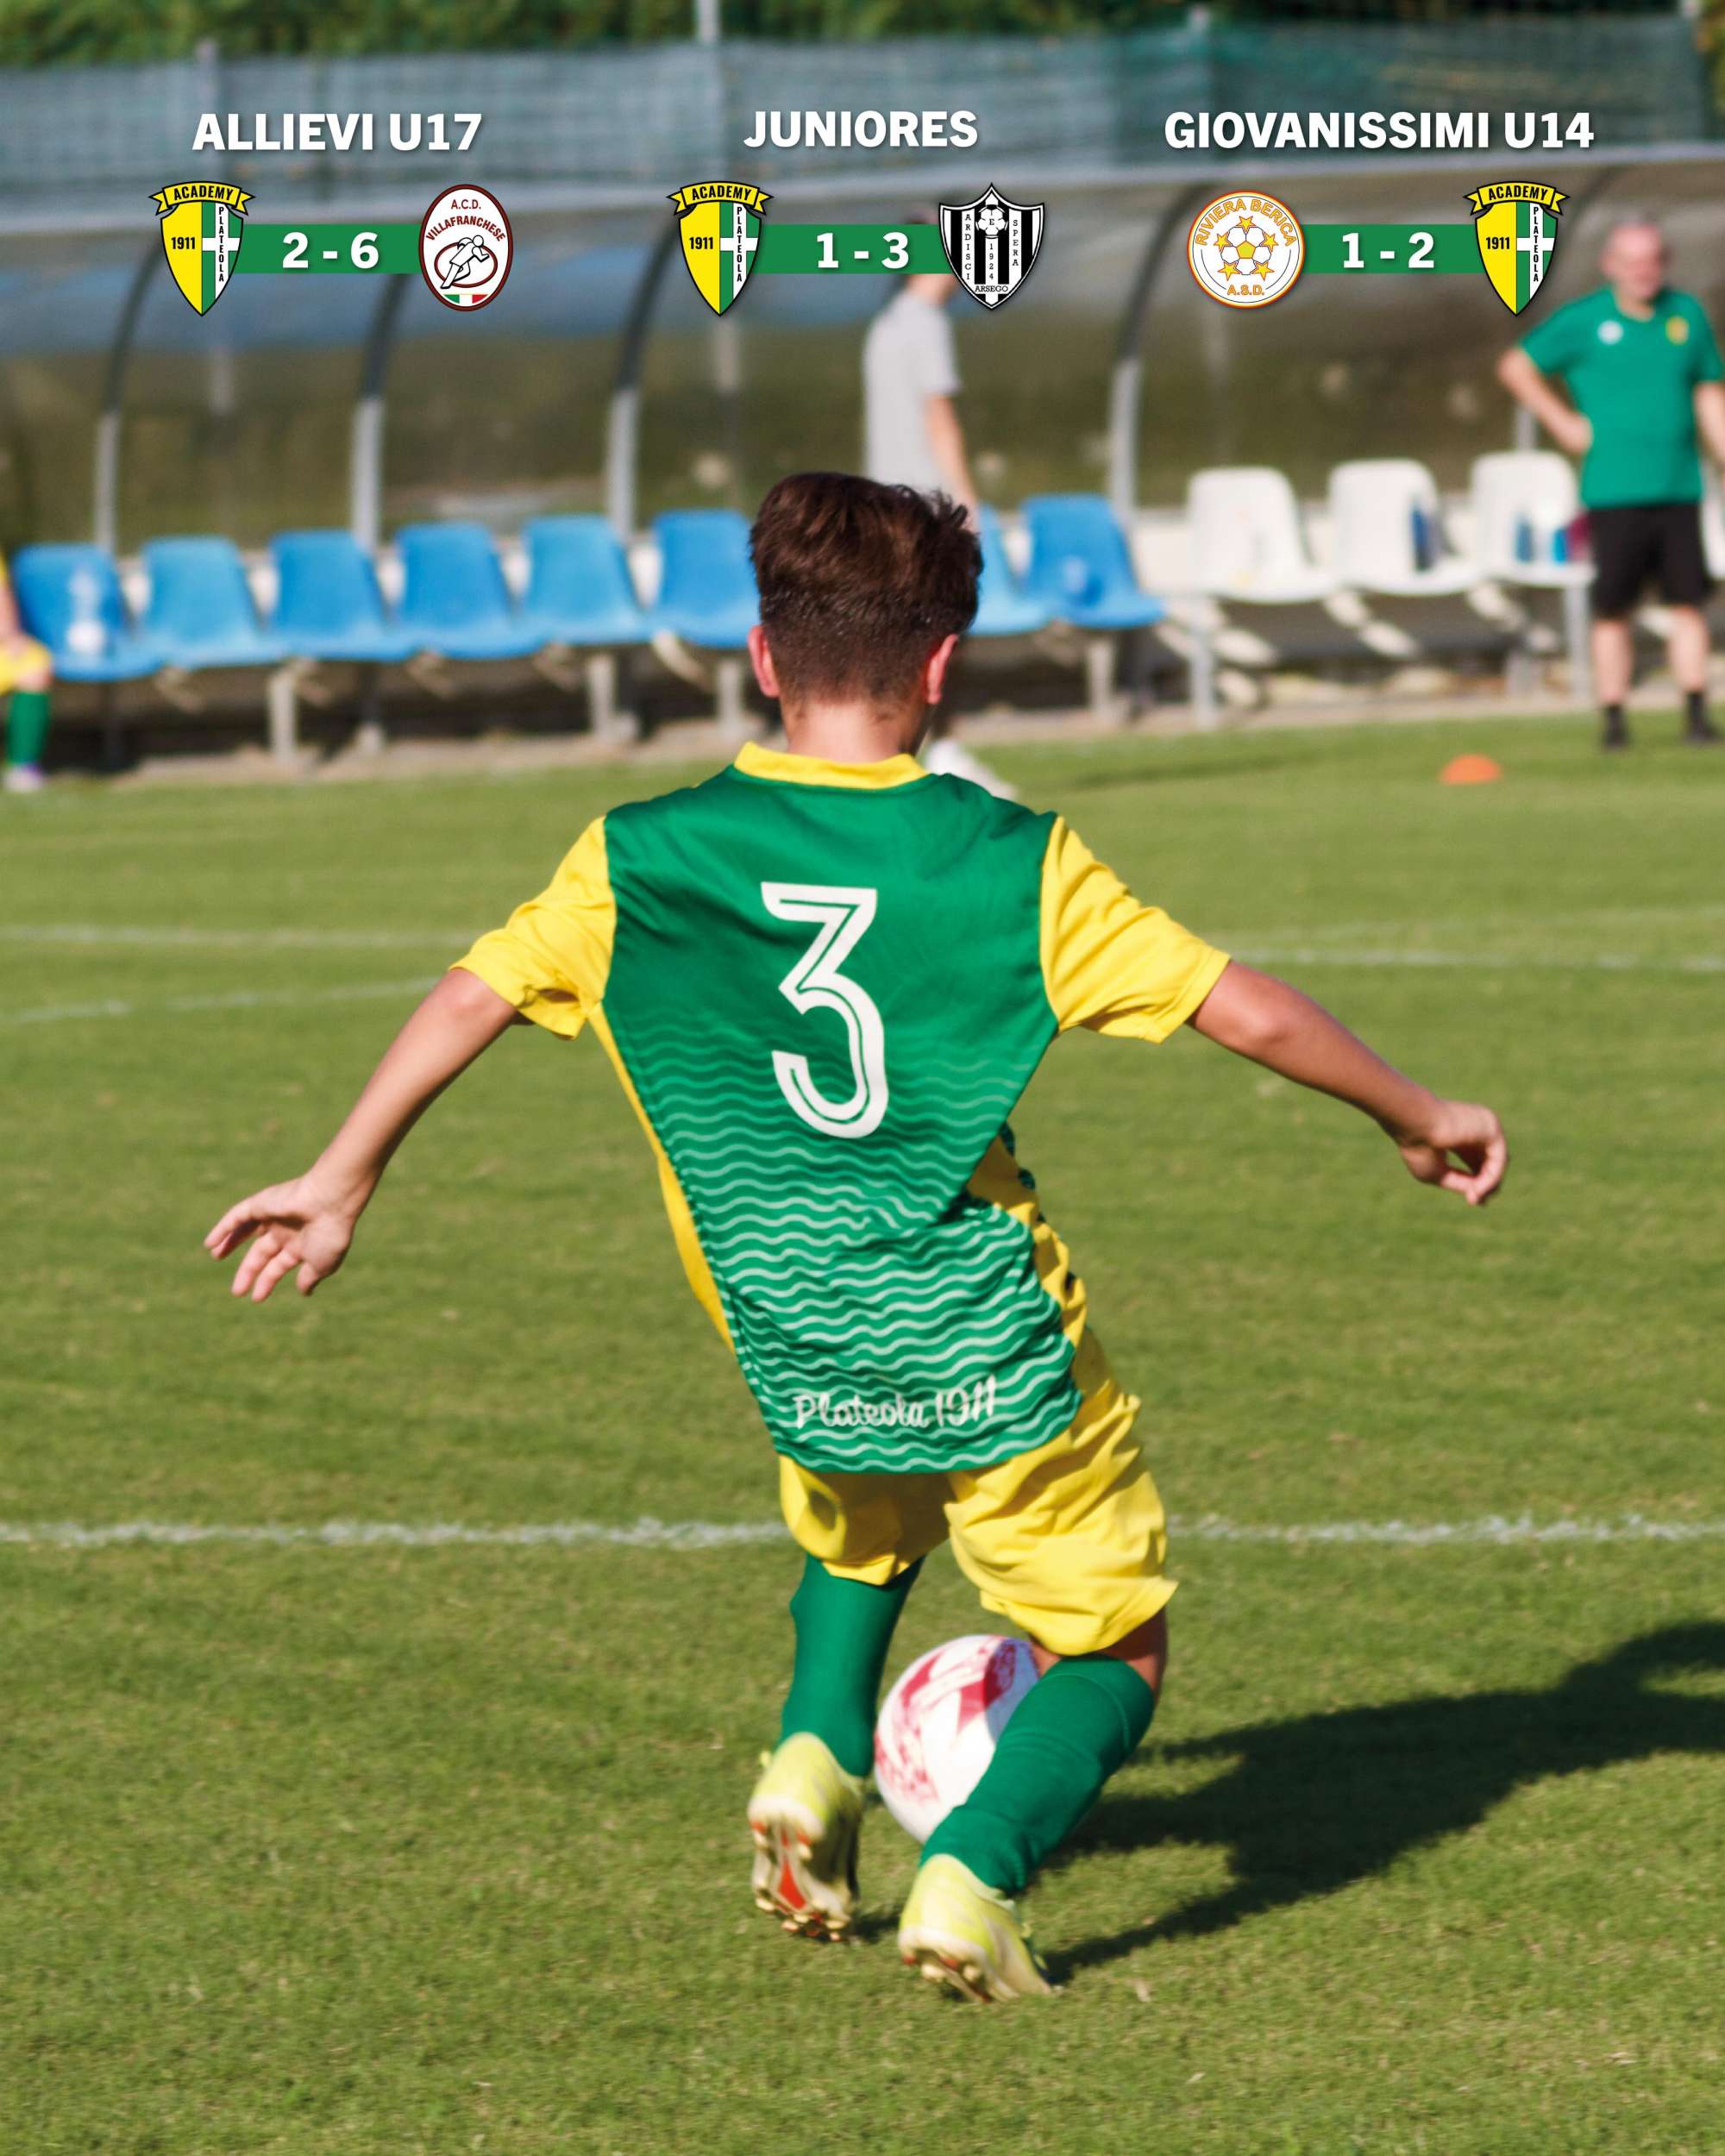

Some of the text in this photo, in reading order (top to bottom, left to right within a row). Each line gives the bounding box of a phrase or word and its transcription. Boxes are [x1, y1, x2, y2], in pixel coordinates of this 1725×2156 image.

[760, 881, 889, 1139] 3
[793, 1376, 995, 1429] Plateola 1911
